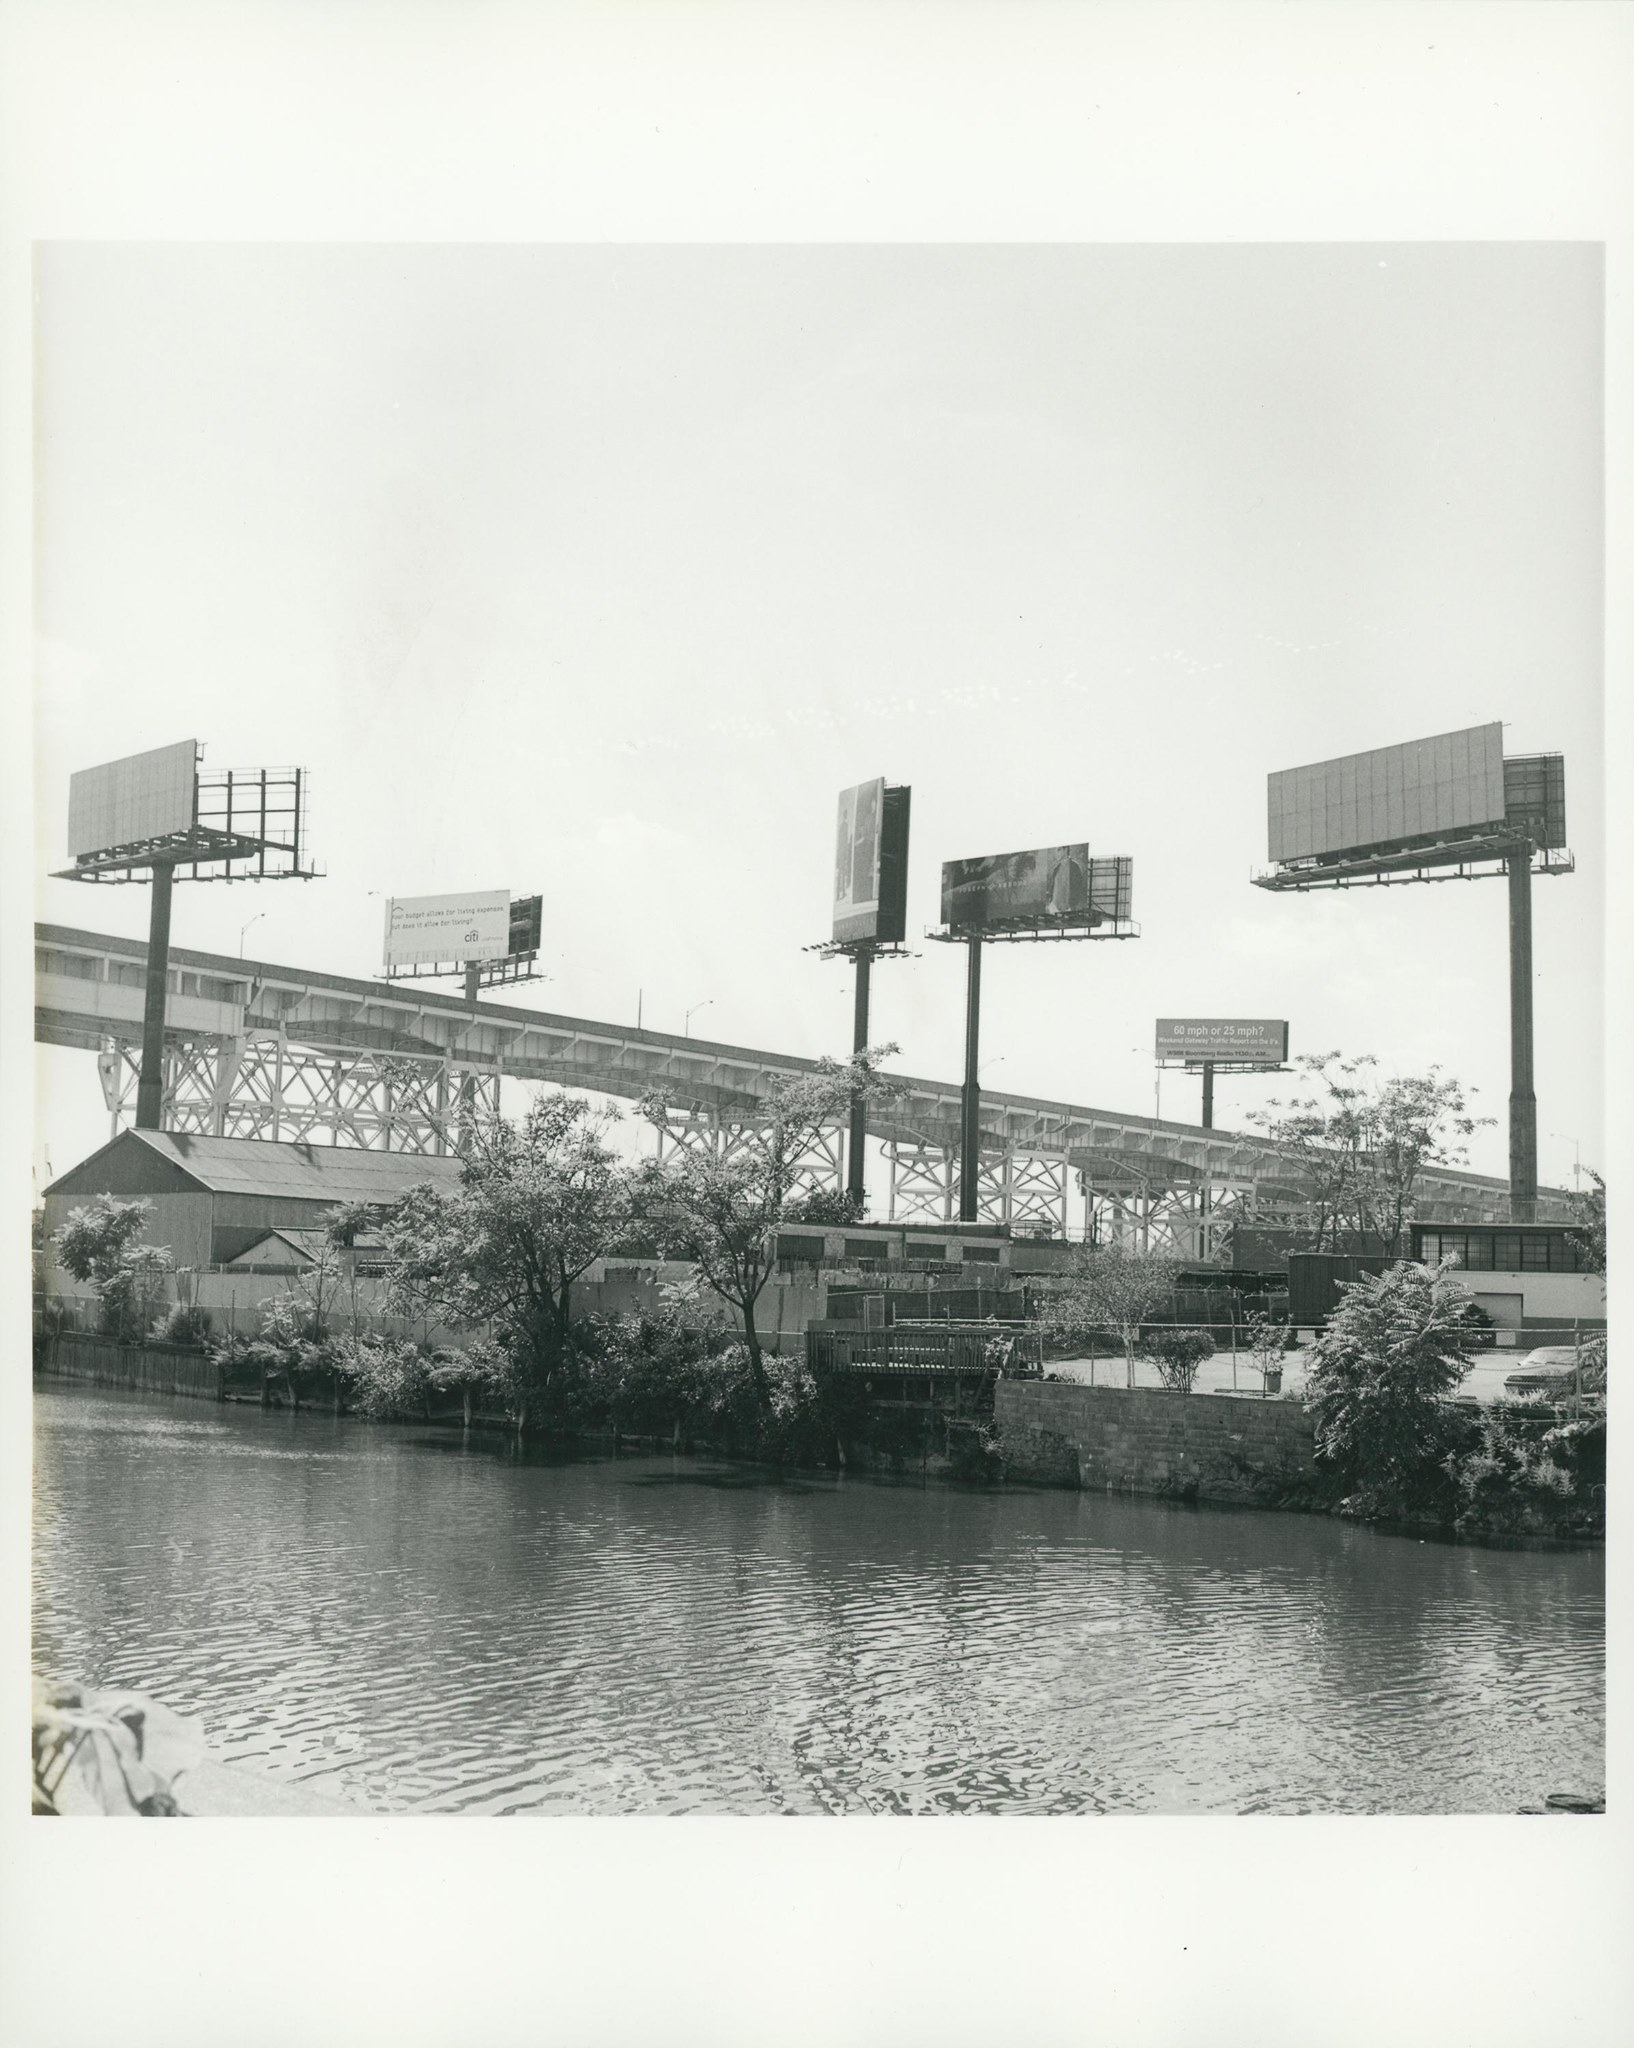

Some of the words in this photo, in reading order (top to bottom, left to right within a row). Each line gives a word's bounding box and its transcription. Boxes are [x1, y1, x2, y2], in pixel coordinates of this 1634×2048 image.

[446, 908, 455, 916] for
[457, 908, 475, 916] living
[465, 930, 479, 943] citi
[1174, 1025, 1185, 1035] 60
[1187, 1026, 1208, 1037] mph
[1211, 1028, 1221, 1036] or
[1223, 1025, 1235, 1036] 25
[1237, 1026, 1265, 1037] mph?
